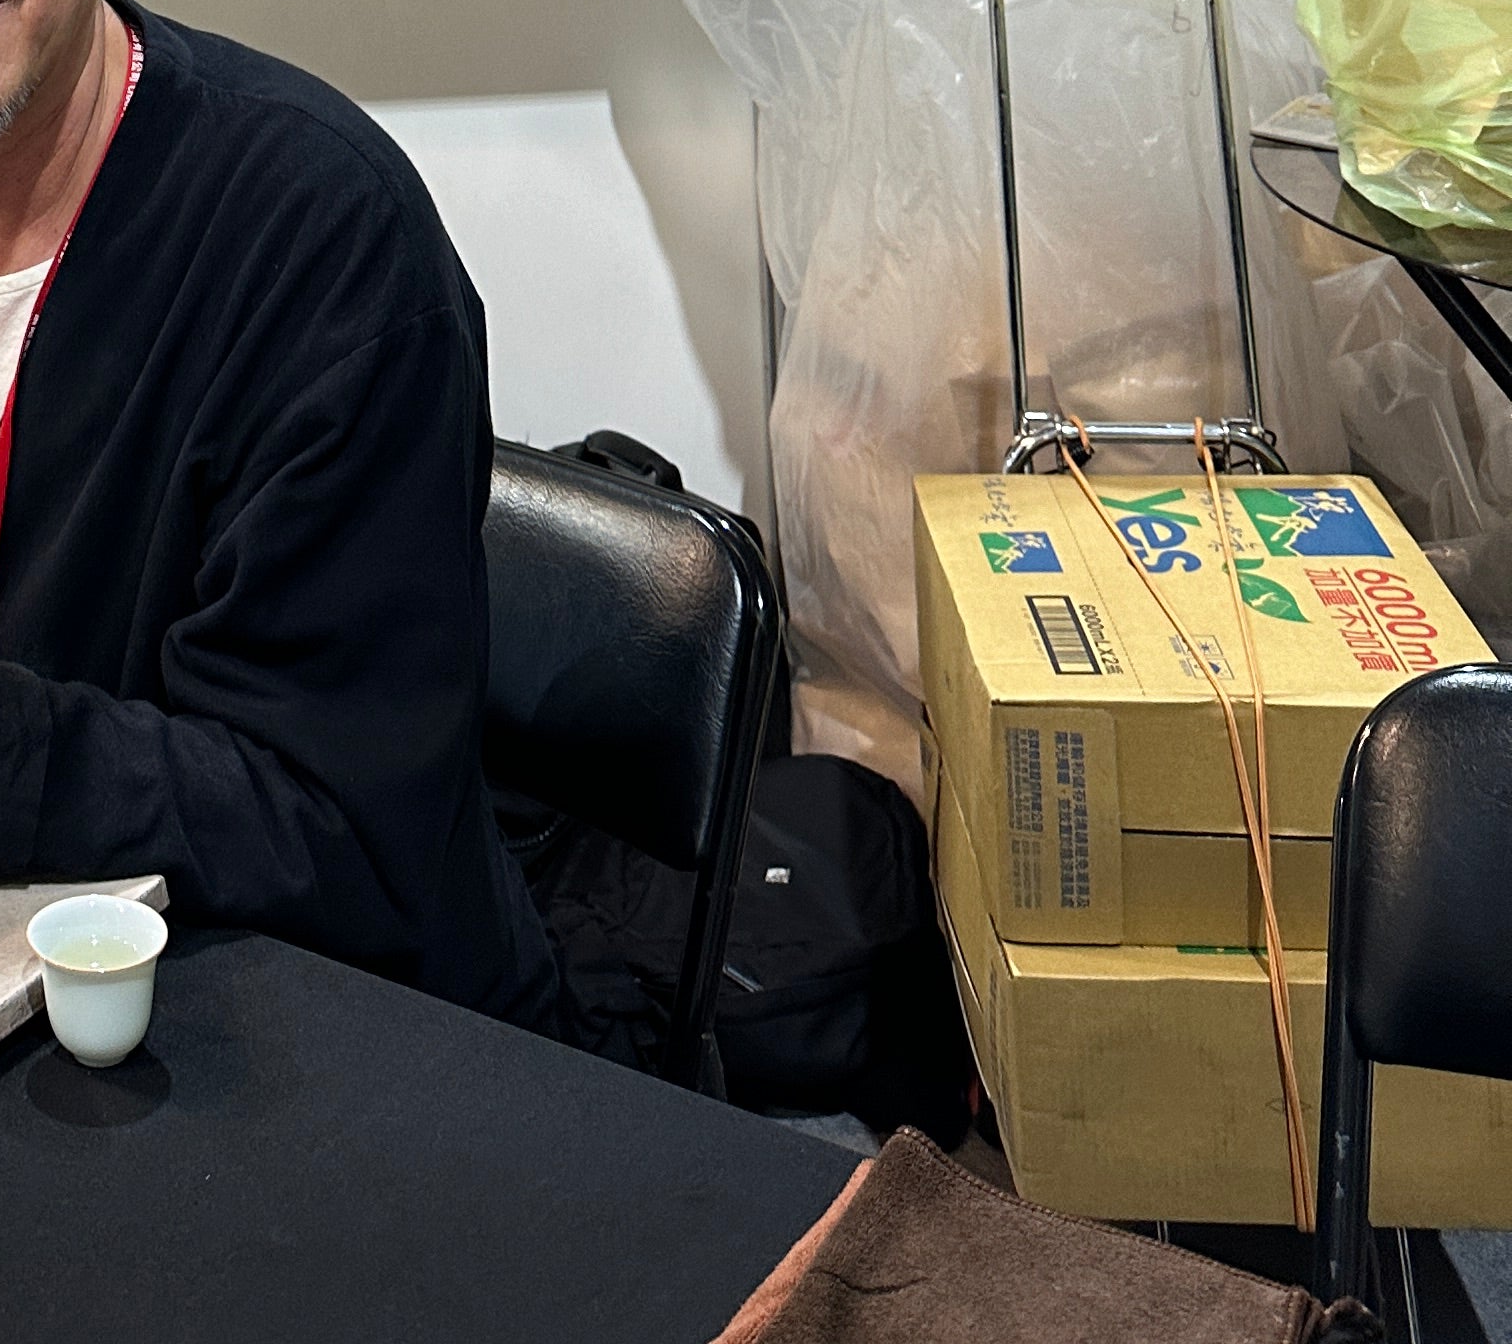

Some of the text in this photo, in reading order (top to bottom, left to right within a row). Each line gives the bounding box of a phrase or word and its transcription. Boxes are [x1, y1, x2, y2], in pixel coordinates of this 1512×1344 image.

[1303, 568, 1400, 672] 加量不加價
